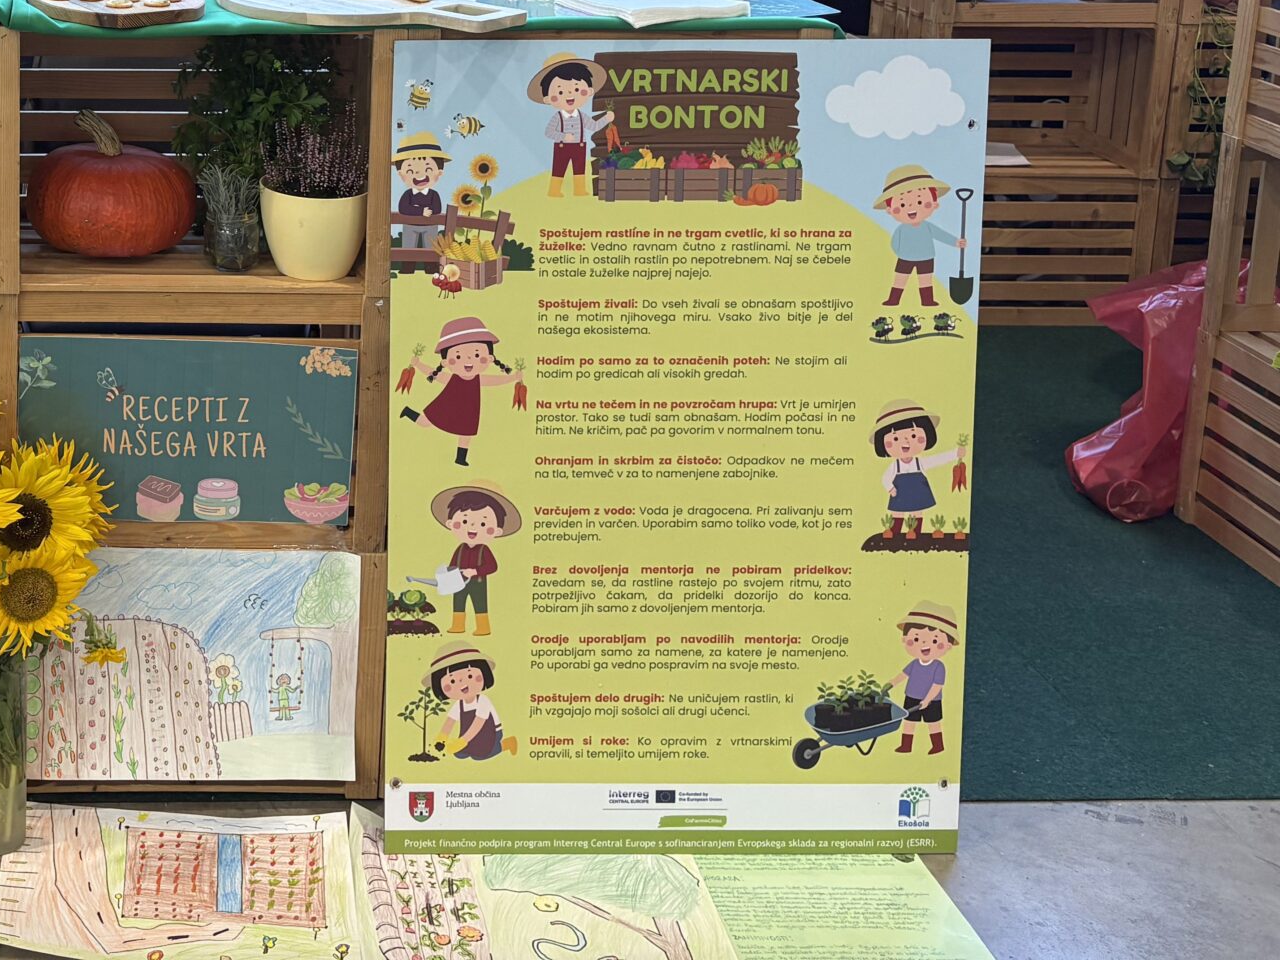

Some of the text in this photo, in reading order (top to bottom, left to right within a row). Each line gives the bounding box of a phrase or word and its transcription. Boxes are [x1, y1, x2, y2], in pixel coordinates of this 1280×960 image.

[607, 68, 789, 94] VRTNARSKI
[628, 105, 766, 129] BONTON
[540, 227, 602, 241] Spoštujem
[654, 228, 664, 238] in
[668, 230, 682, 238] ne
[684, 228, 721, 241] trgam
[725, 228, 766, 240] cvetlic,
[770, 228, 780, 238] ki
[784, 230, 797, 238] so
[800, 228, 835, 238] hrana
[837, 230, 852, 238] za
[538, 298, 853, 312] Spoštujem živali: Do vseh živali se obnašam spoštljivo
[122, 394, 250, 423] RECEPTI Z
[102, 423, 267, 458] NAŠEGA VRTA
[532, 564, 851, 578] Brez dovoljenja mentorja ne pobiram pridelkov:
[531, 634, 848, 648] Orodje uporabljam po navodilih mentorja: Orodje
[530, 735, 792, 748] Umijem si roke: Ko opravim z vrtnarskimi
[446, 790, 501, 798] Mestna občina
[446, 800, 480, 809] Ljubljana
[898, 819, 930, 828] Ekošola
[404, 839, 436, 849] Projekt
[439, 839, 477, 847] finančno
[478, 839, 512, 849] podpira
[514, 840, 551, 849] program
[553, 839, 588, 849] Interreg
[591, 839, 623, 847] Central
[625, 839, 656, 849] Europe
[665, 839, 735, 849] sofinanciranjem
[738, 839, 786, 849] Evropskega
[788, 839, 816, 847] sklada
[831, 839, 874, 849] regionalni
[876, 839, 904, 849] razvoj
[906, 839, 938, 849] (ESRR).
